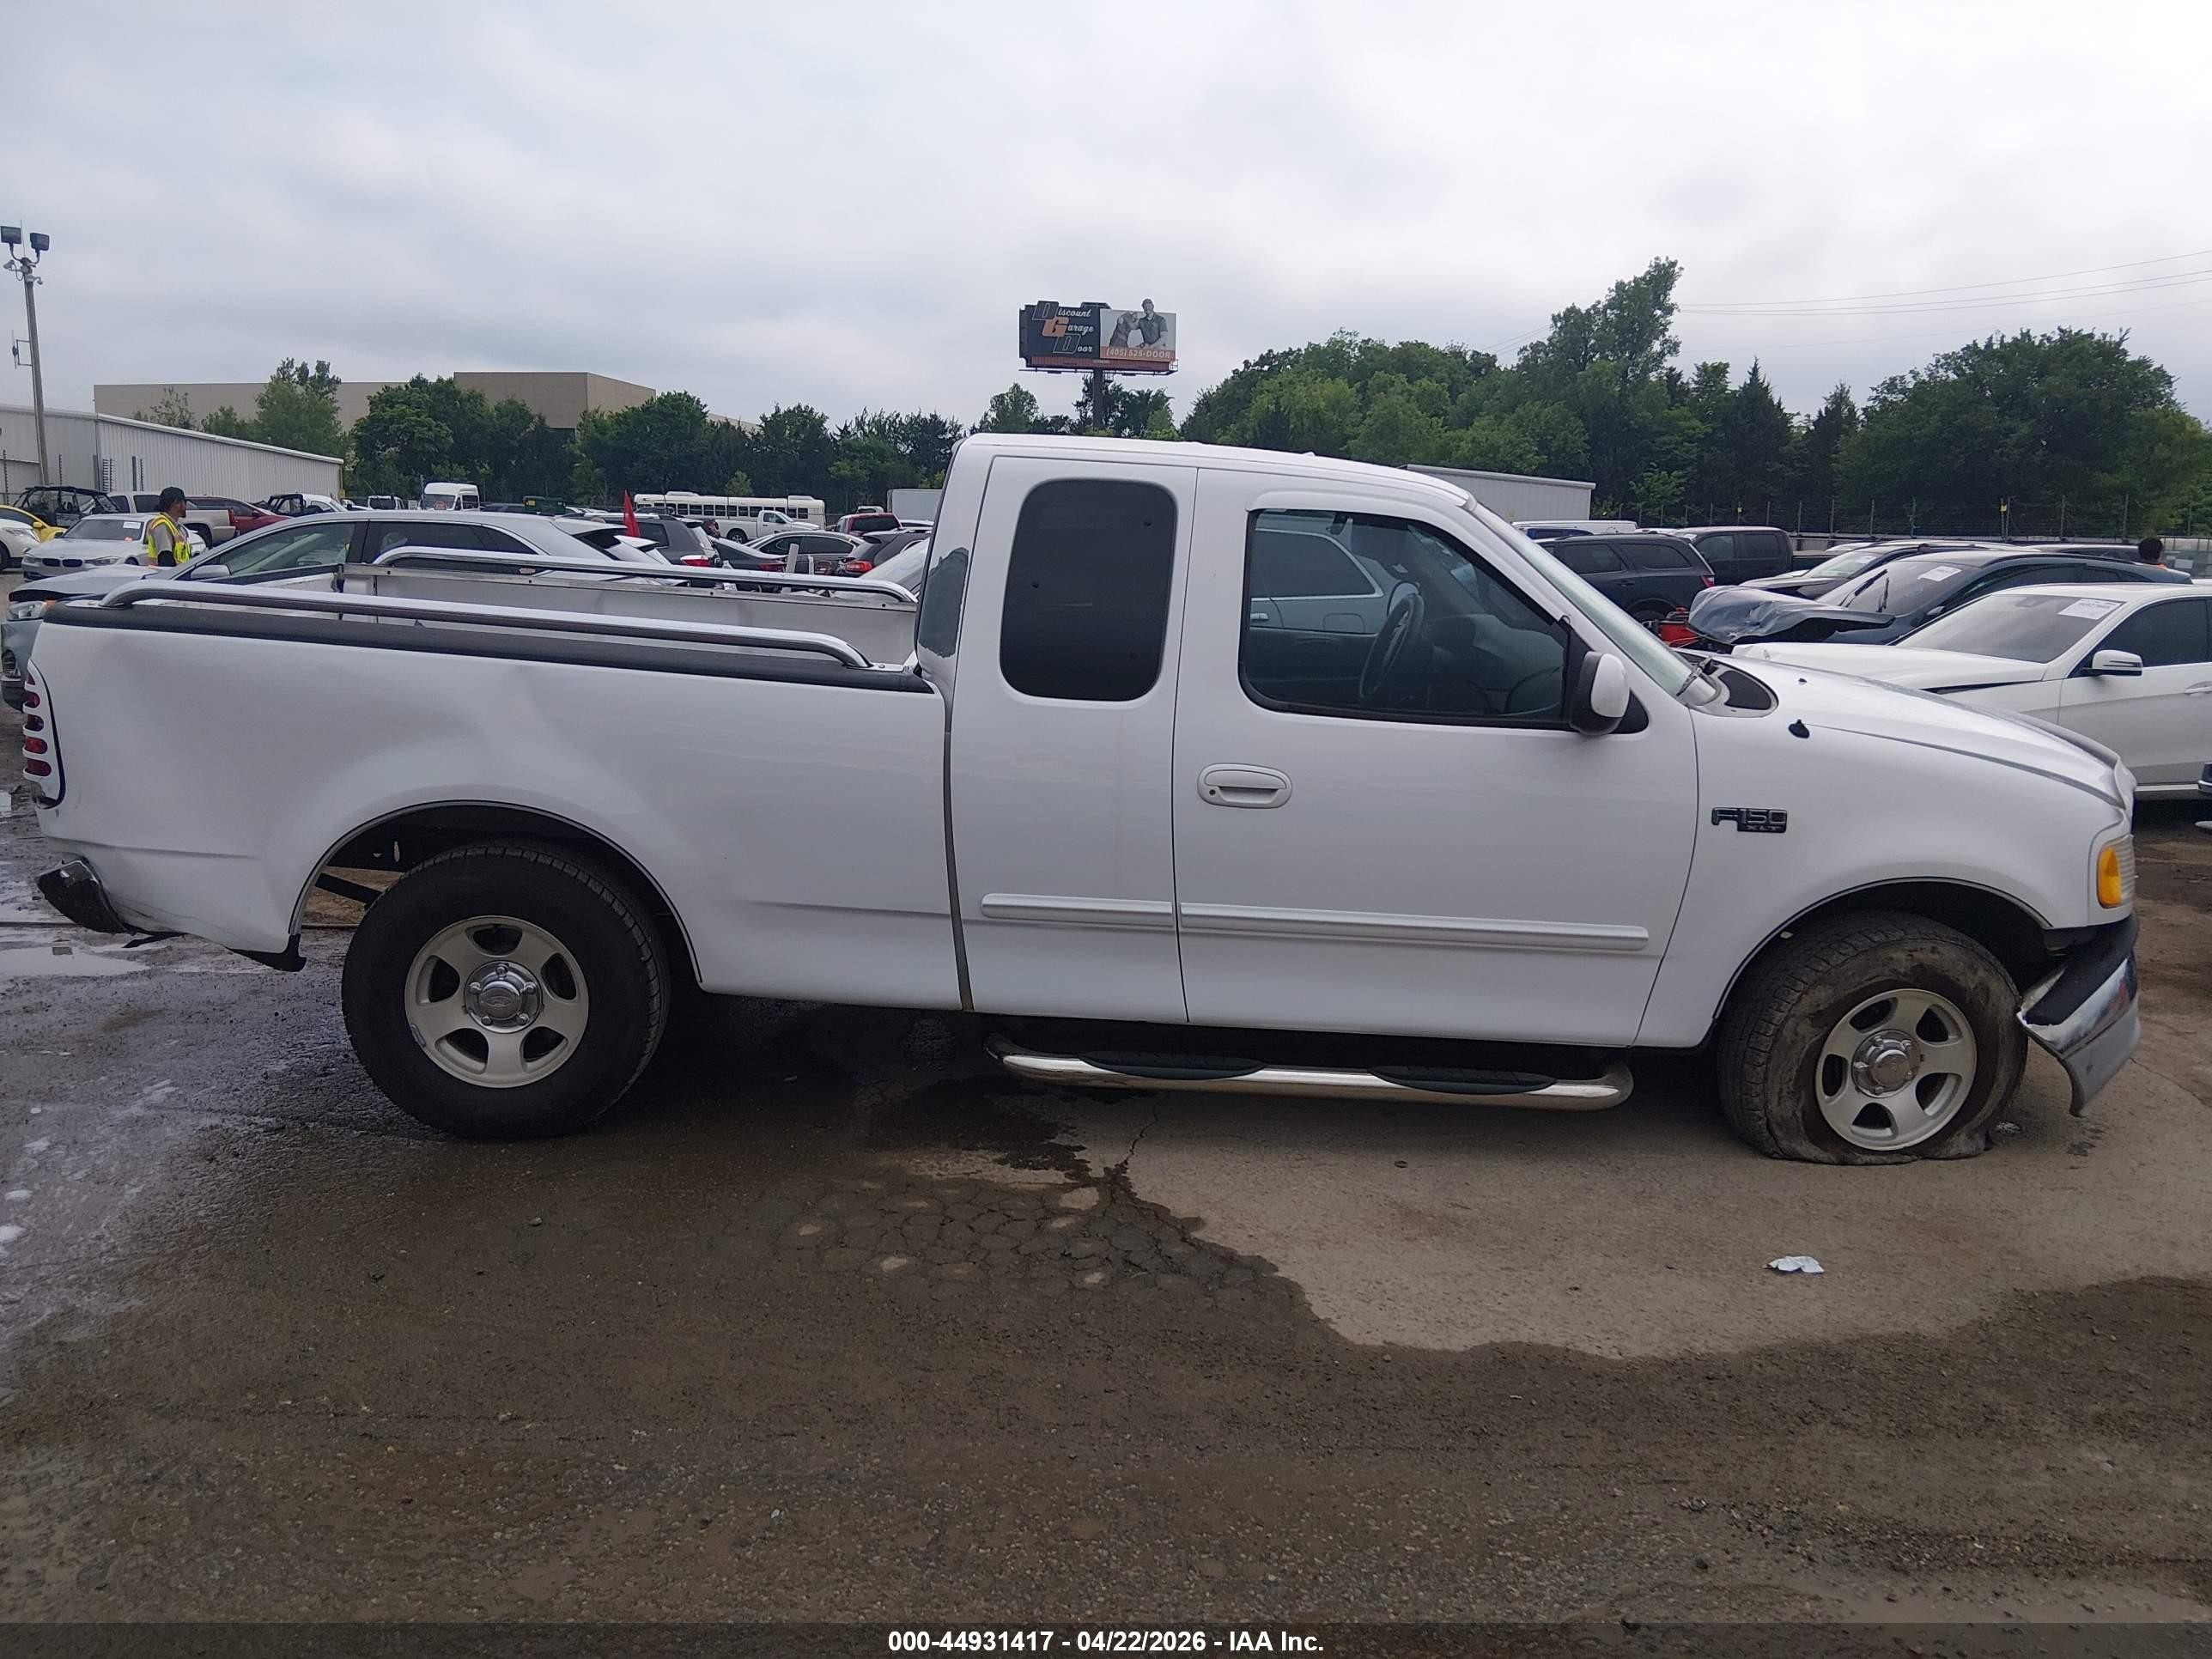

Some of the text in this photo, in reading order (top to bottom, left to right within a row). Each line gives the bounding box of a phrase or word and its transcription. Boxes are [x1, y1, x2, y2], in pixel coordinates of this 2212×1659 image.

[1032, 301, 1091, 320] Discount
[1042, 315, 1094, 337] Garage
[1053, 333, 1092, 354] Door
[1106, 347, 1127, 356] (405)
[1711, 807, 1787, 826] F150
